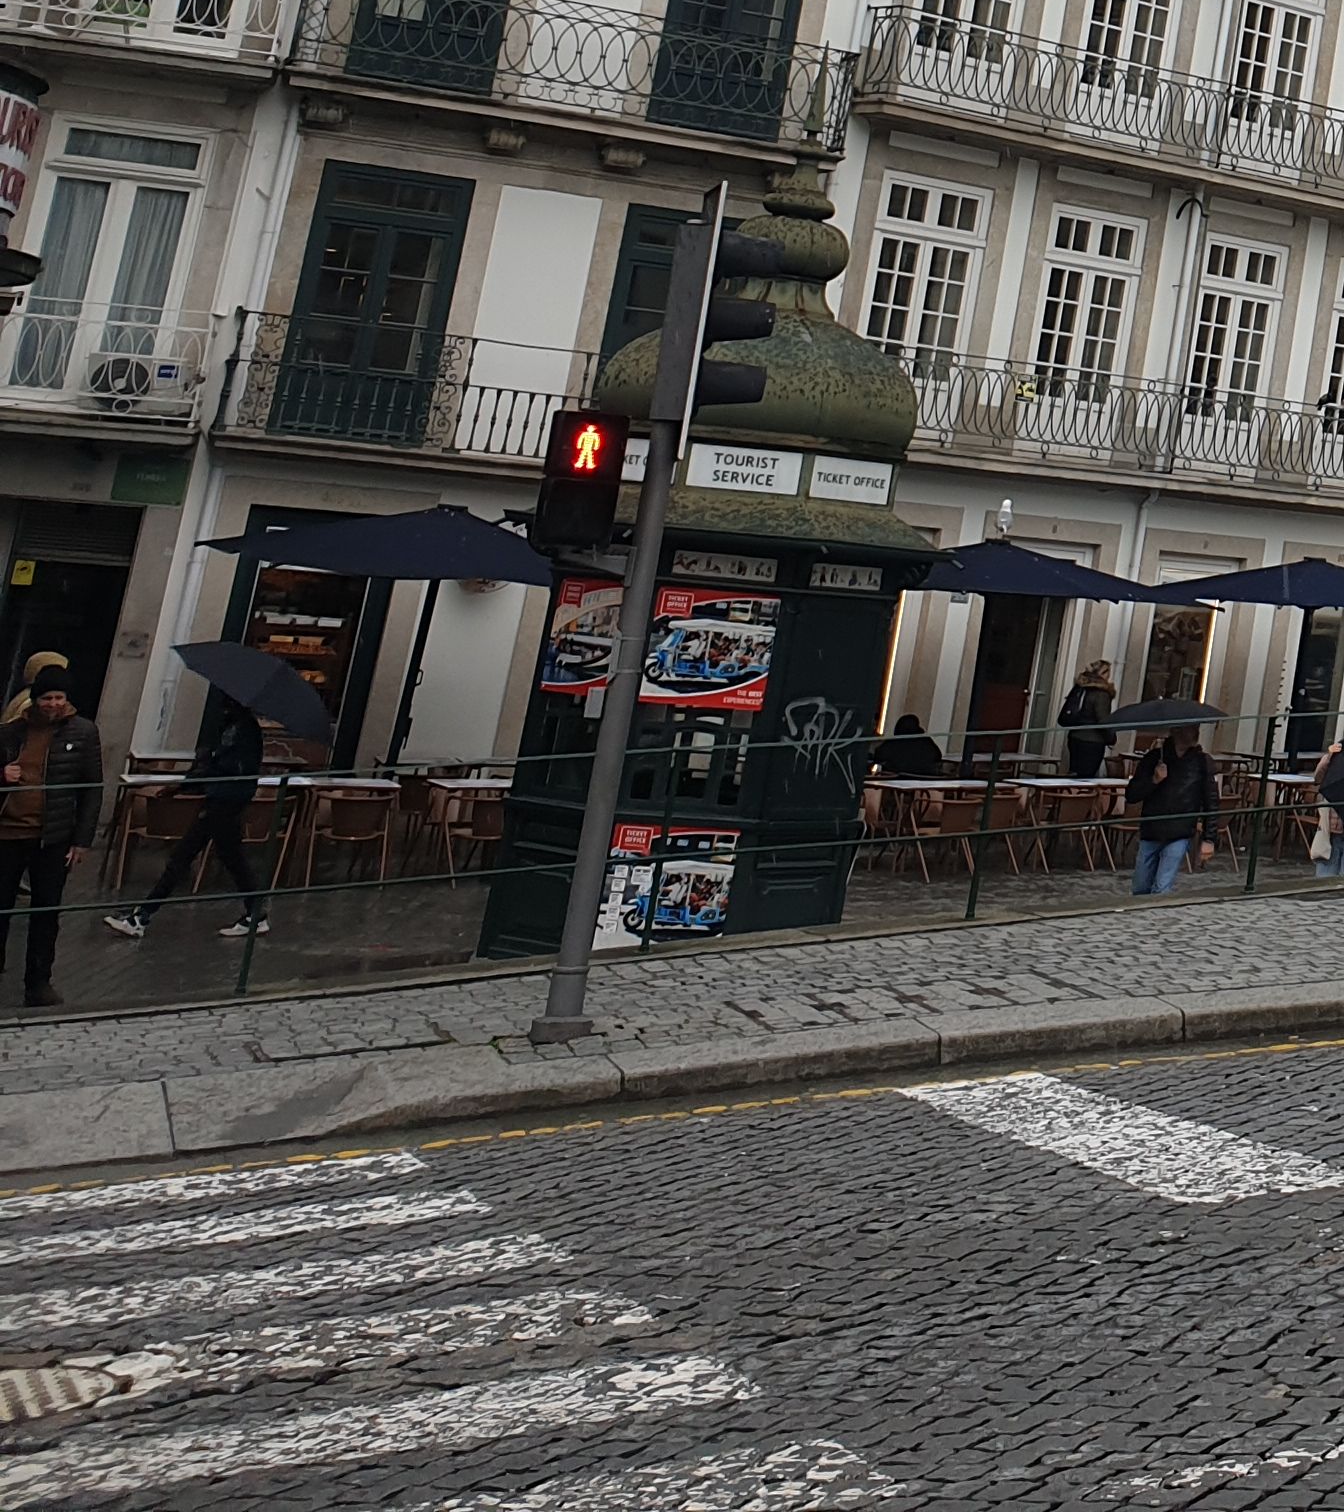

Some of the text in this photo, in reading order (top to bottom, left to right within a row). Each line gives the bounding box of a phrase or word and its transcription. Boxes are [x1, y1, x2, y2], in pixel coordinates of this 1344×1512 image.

[714, 452, 780, 470] TOURIST
[712, 469, 775, 487] SERVICE
[816, 471, 887, 489] TICKET OFFICE
